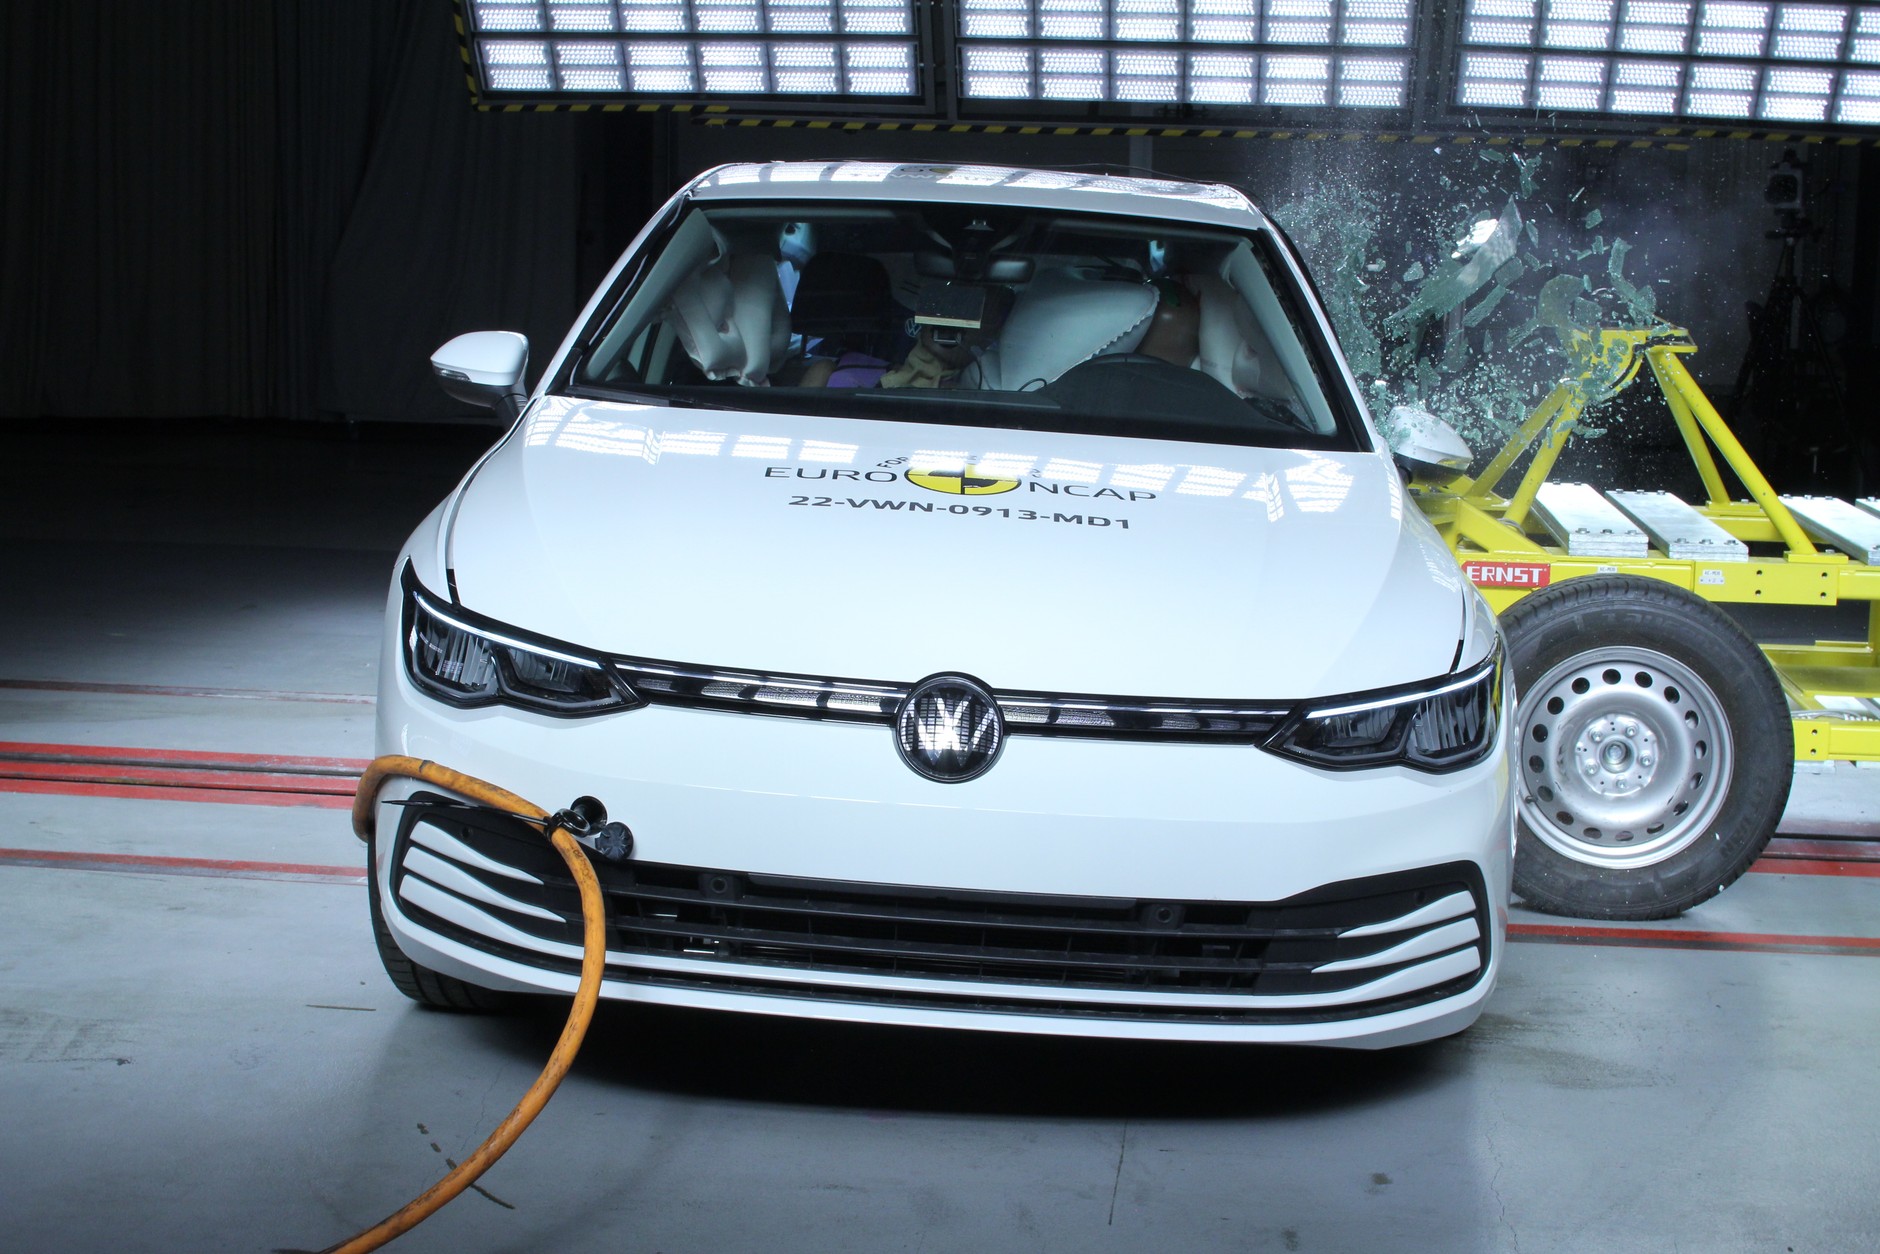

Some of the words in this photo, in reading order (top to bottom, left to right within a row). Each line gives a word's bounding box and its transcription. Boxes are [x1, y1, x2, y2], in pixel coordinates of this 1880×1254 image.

[764, 466, 898, 483] EURO
[1029, 481, 1157, 501] NCAP
[788, 495, 1129, 529] 22-VWN-0913-MD1
[1466, 565, 1544, 583] ERNST
